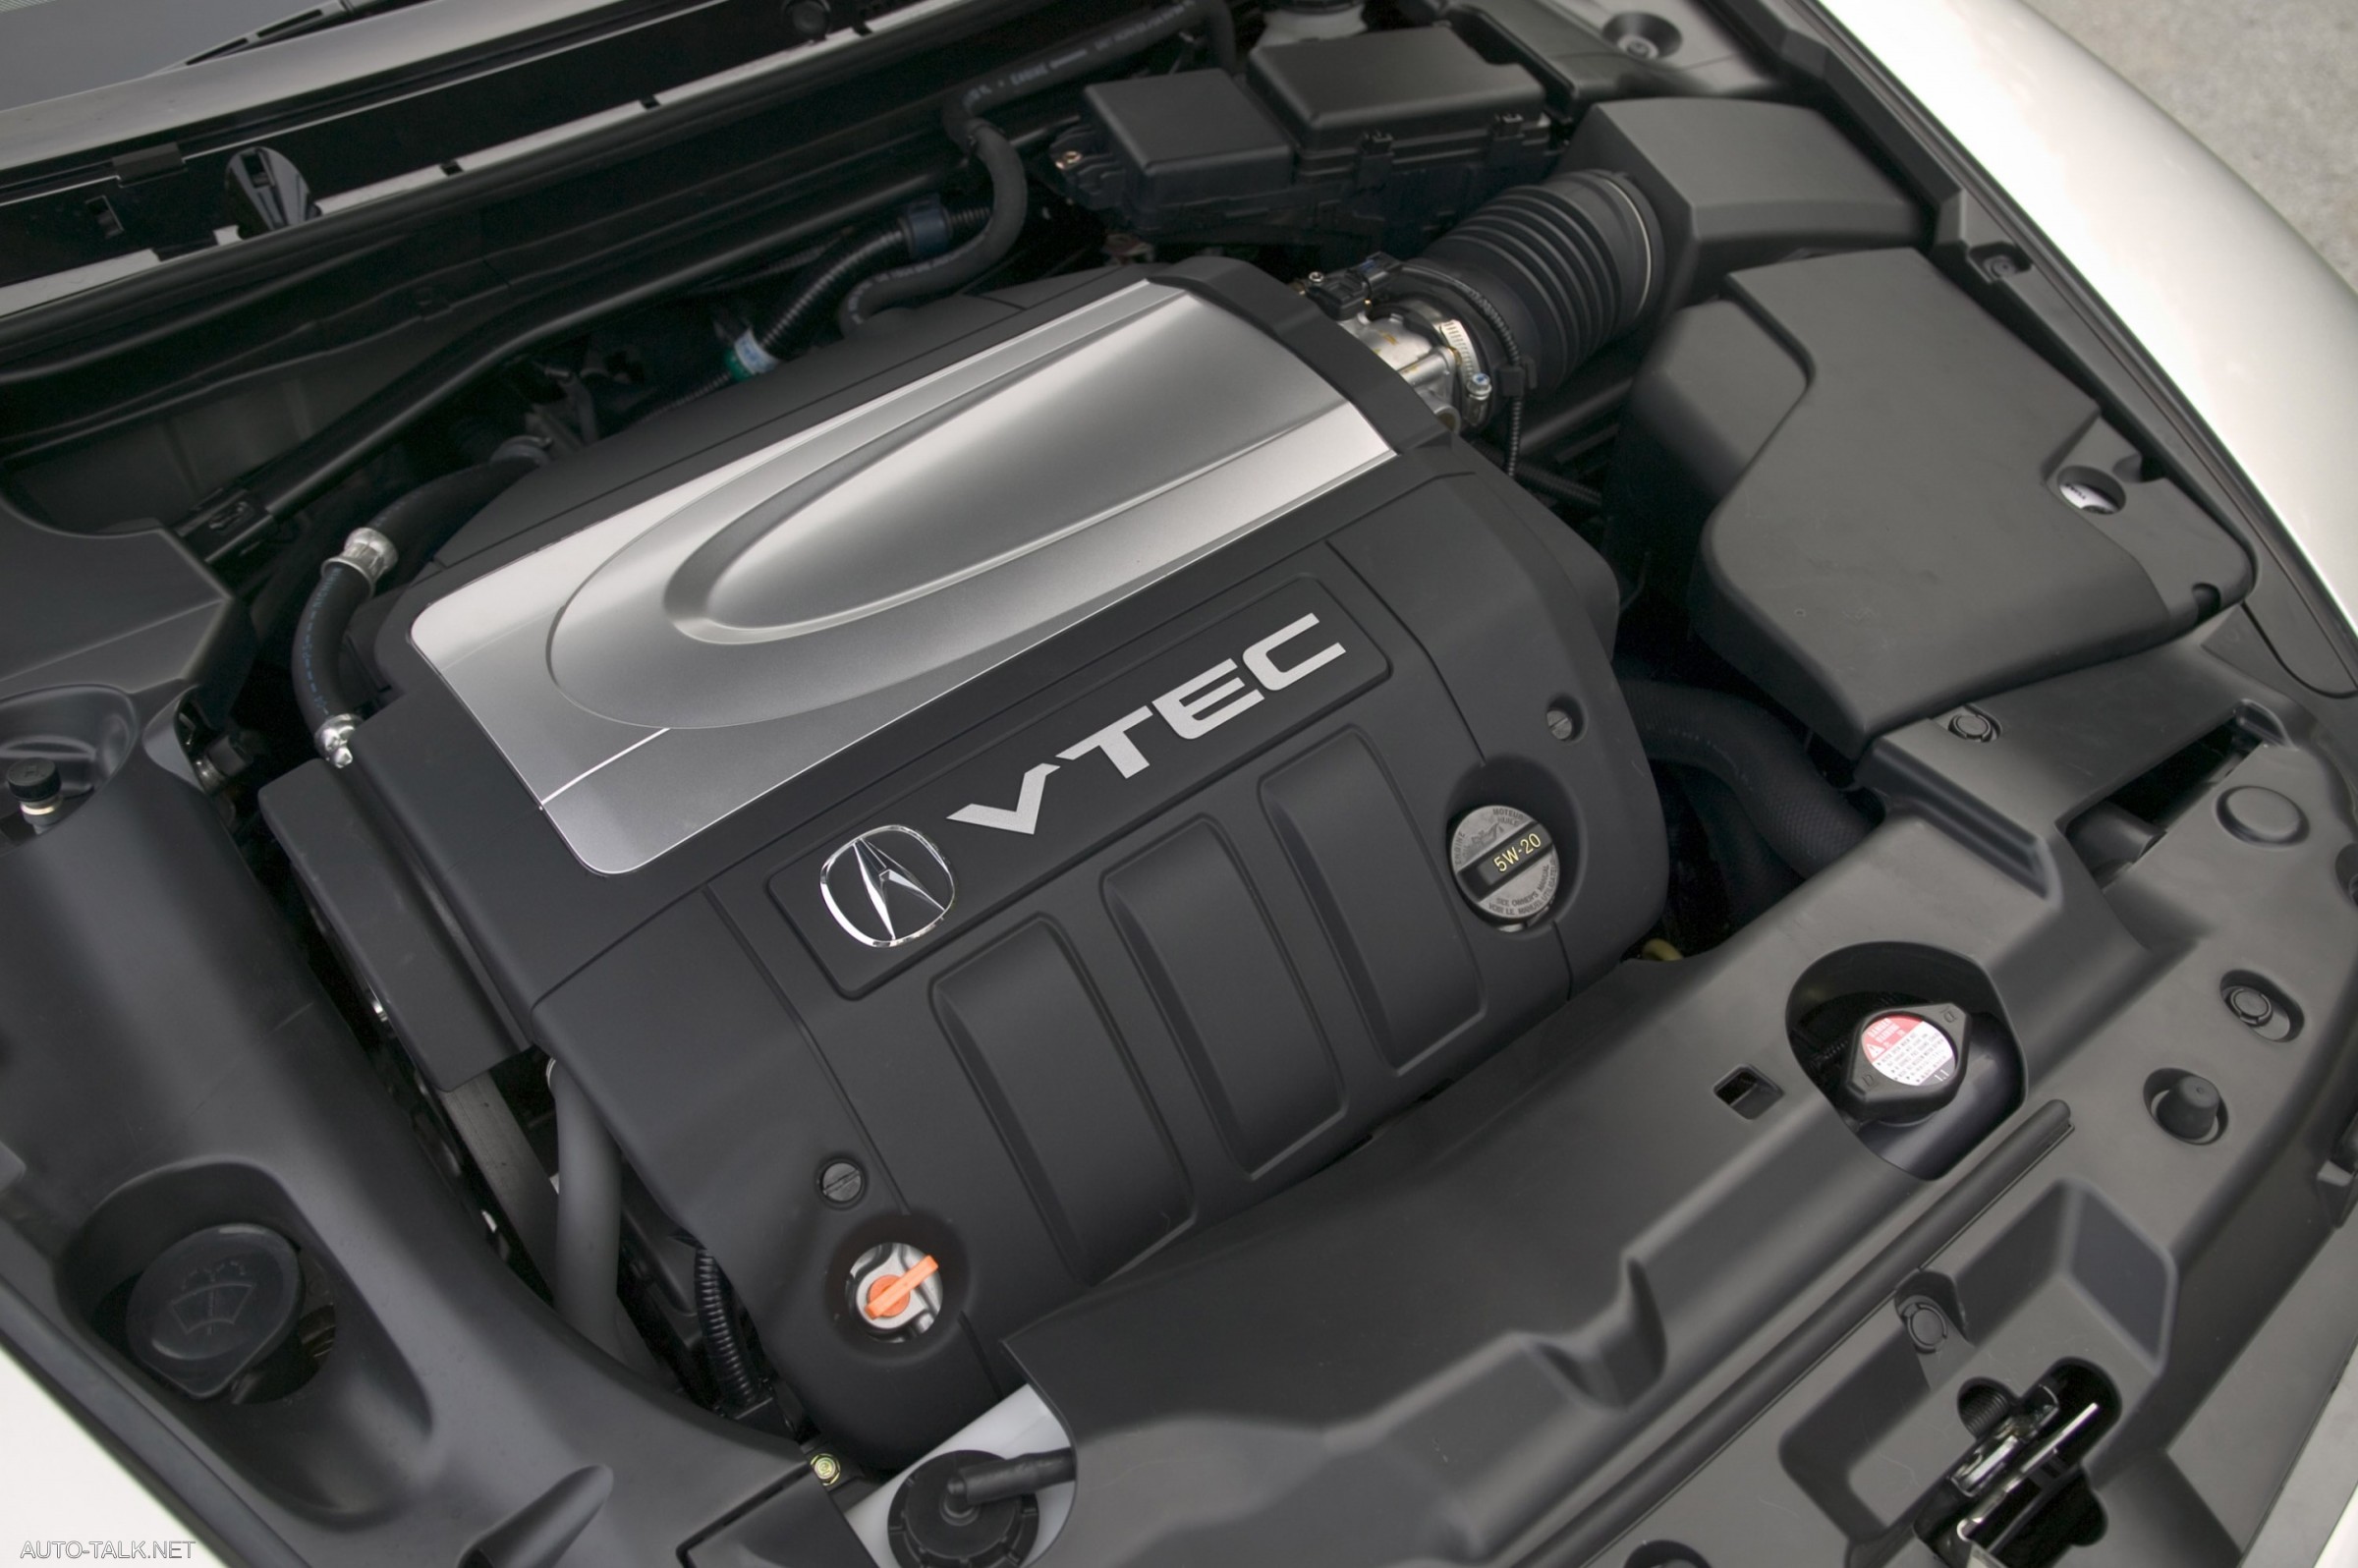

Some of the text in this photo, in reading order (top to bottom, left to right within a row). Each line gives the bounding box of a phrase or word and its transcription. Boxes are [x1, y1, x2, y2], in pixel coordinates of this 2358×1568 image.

[946, 612, 1346, 835] VTEC
[1492, 808, 1525, 820] MOTEUR
[1497, 816, 1521, 826] HUILE
[1454, 831, 1466, 865] ENGINE
[1493, 832, 1542, 872] 5W-20
[1496, 897, 1510, 907] SEE
[1538, 865, 1550, 892] MANUAL
[1488, 902, 1504, 914] VOIR
[1517, 899, 1544, 915] MANUEL
